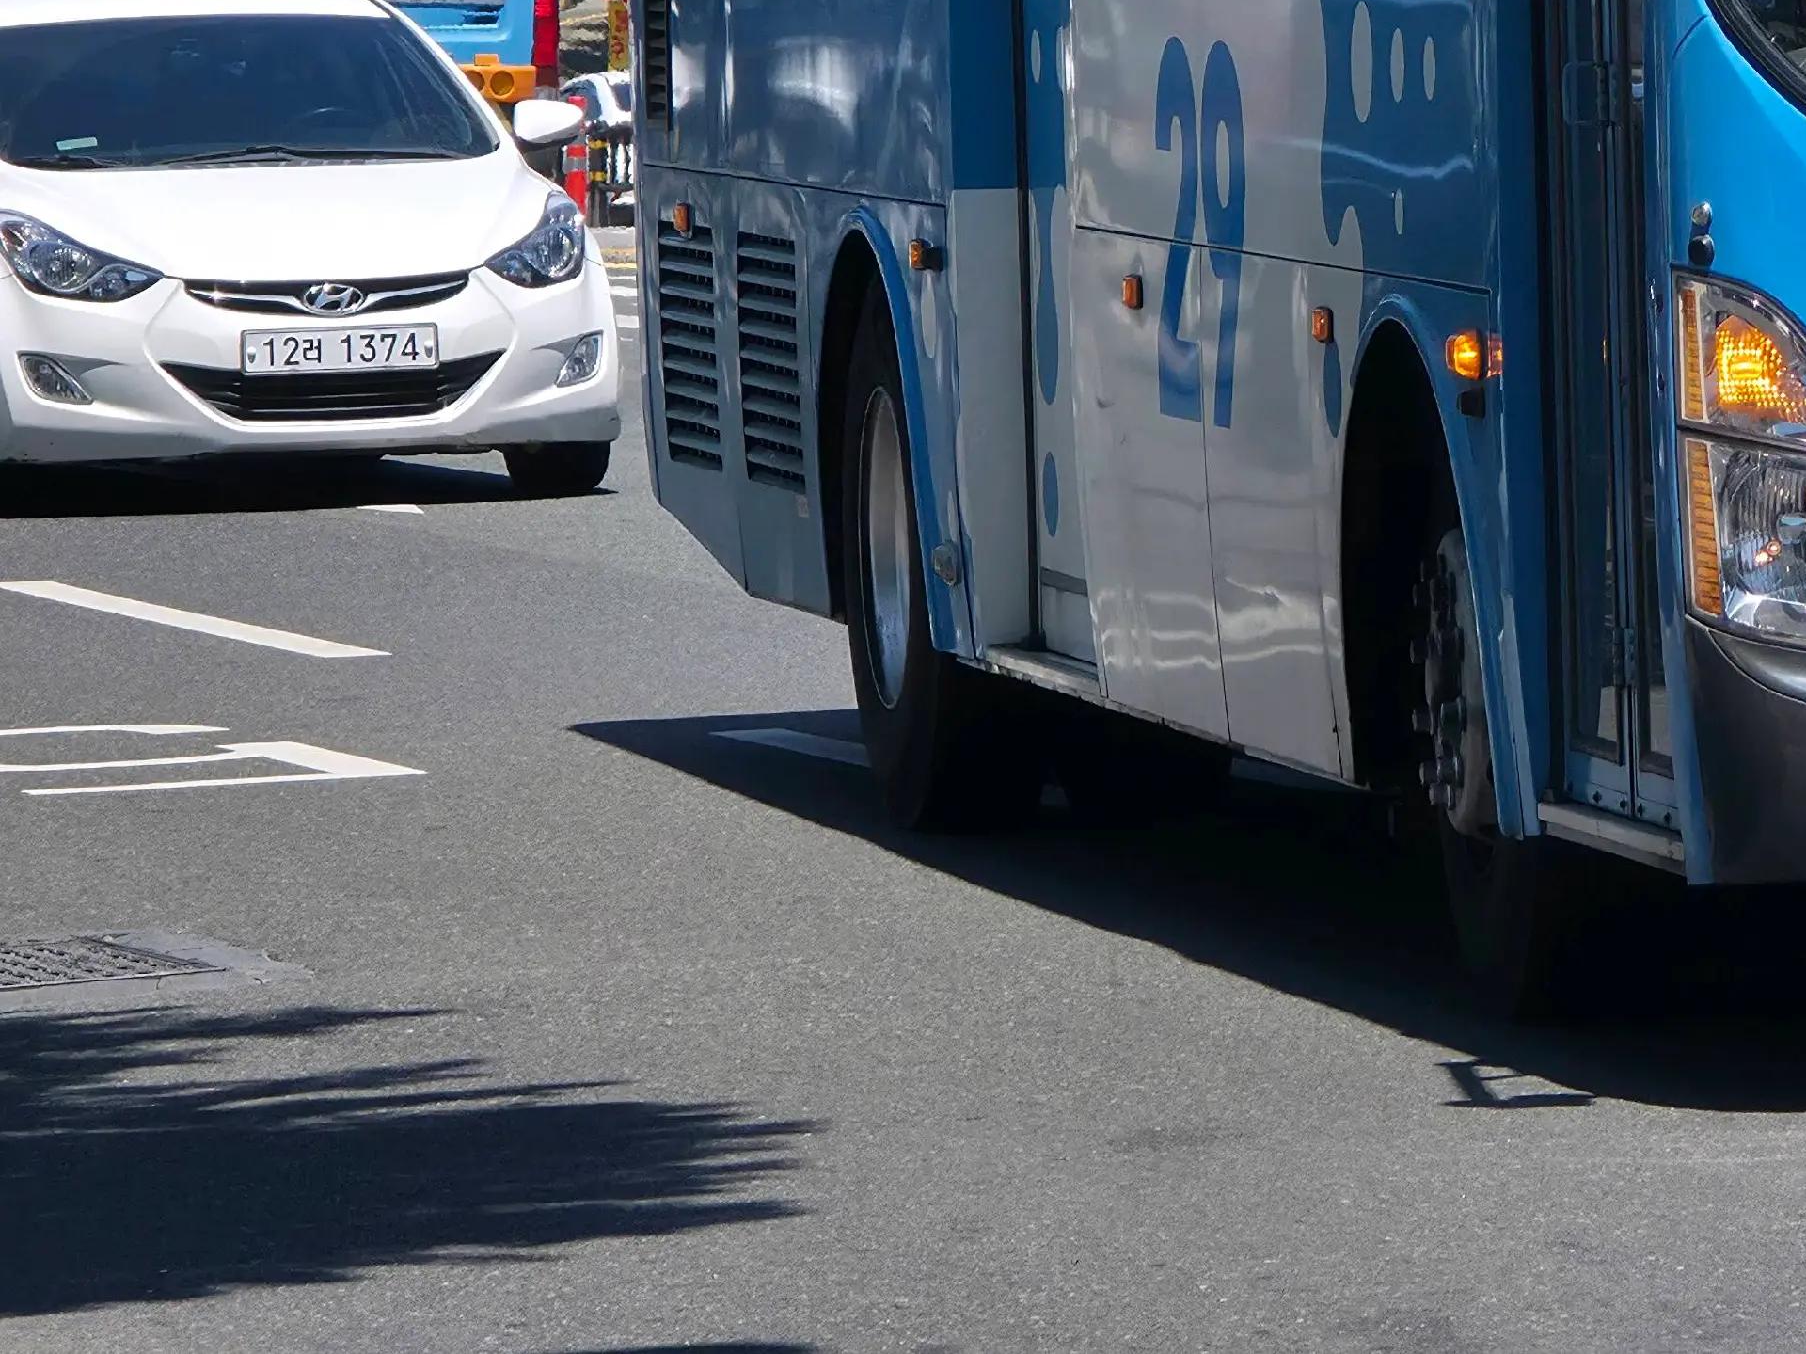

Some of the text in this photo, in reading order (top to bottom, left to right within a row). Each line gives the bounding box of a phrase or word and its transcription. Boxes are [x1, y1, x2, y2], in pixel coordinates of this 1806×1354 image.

[1155, 36, 1246, 429] 29
[262, 332, 420, 366] 12러 1374
